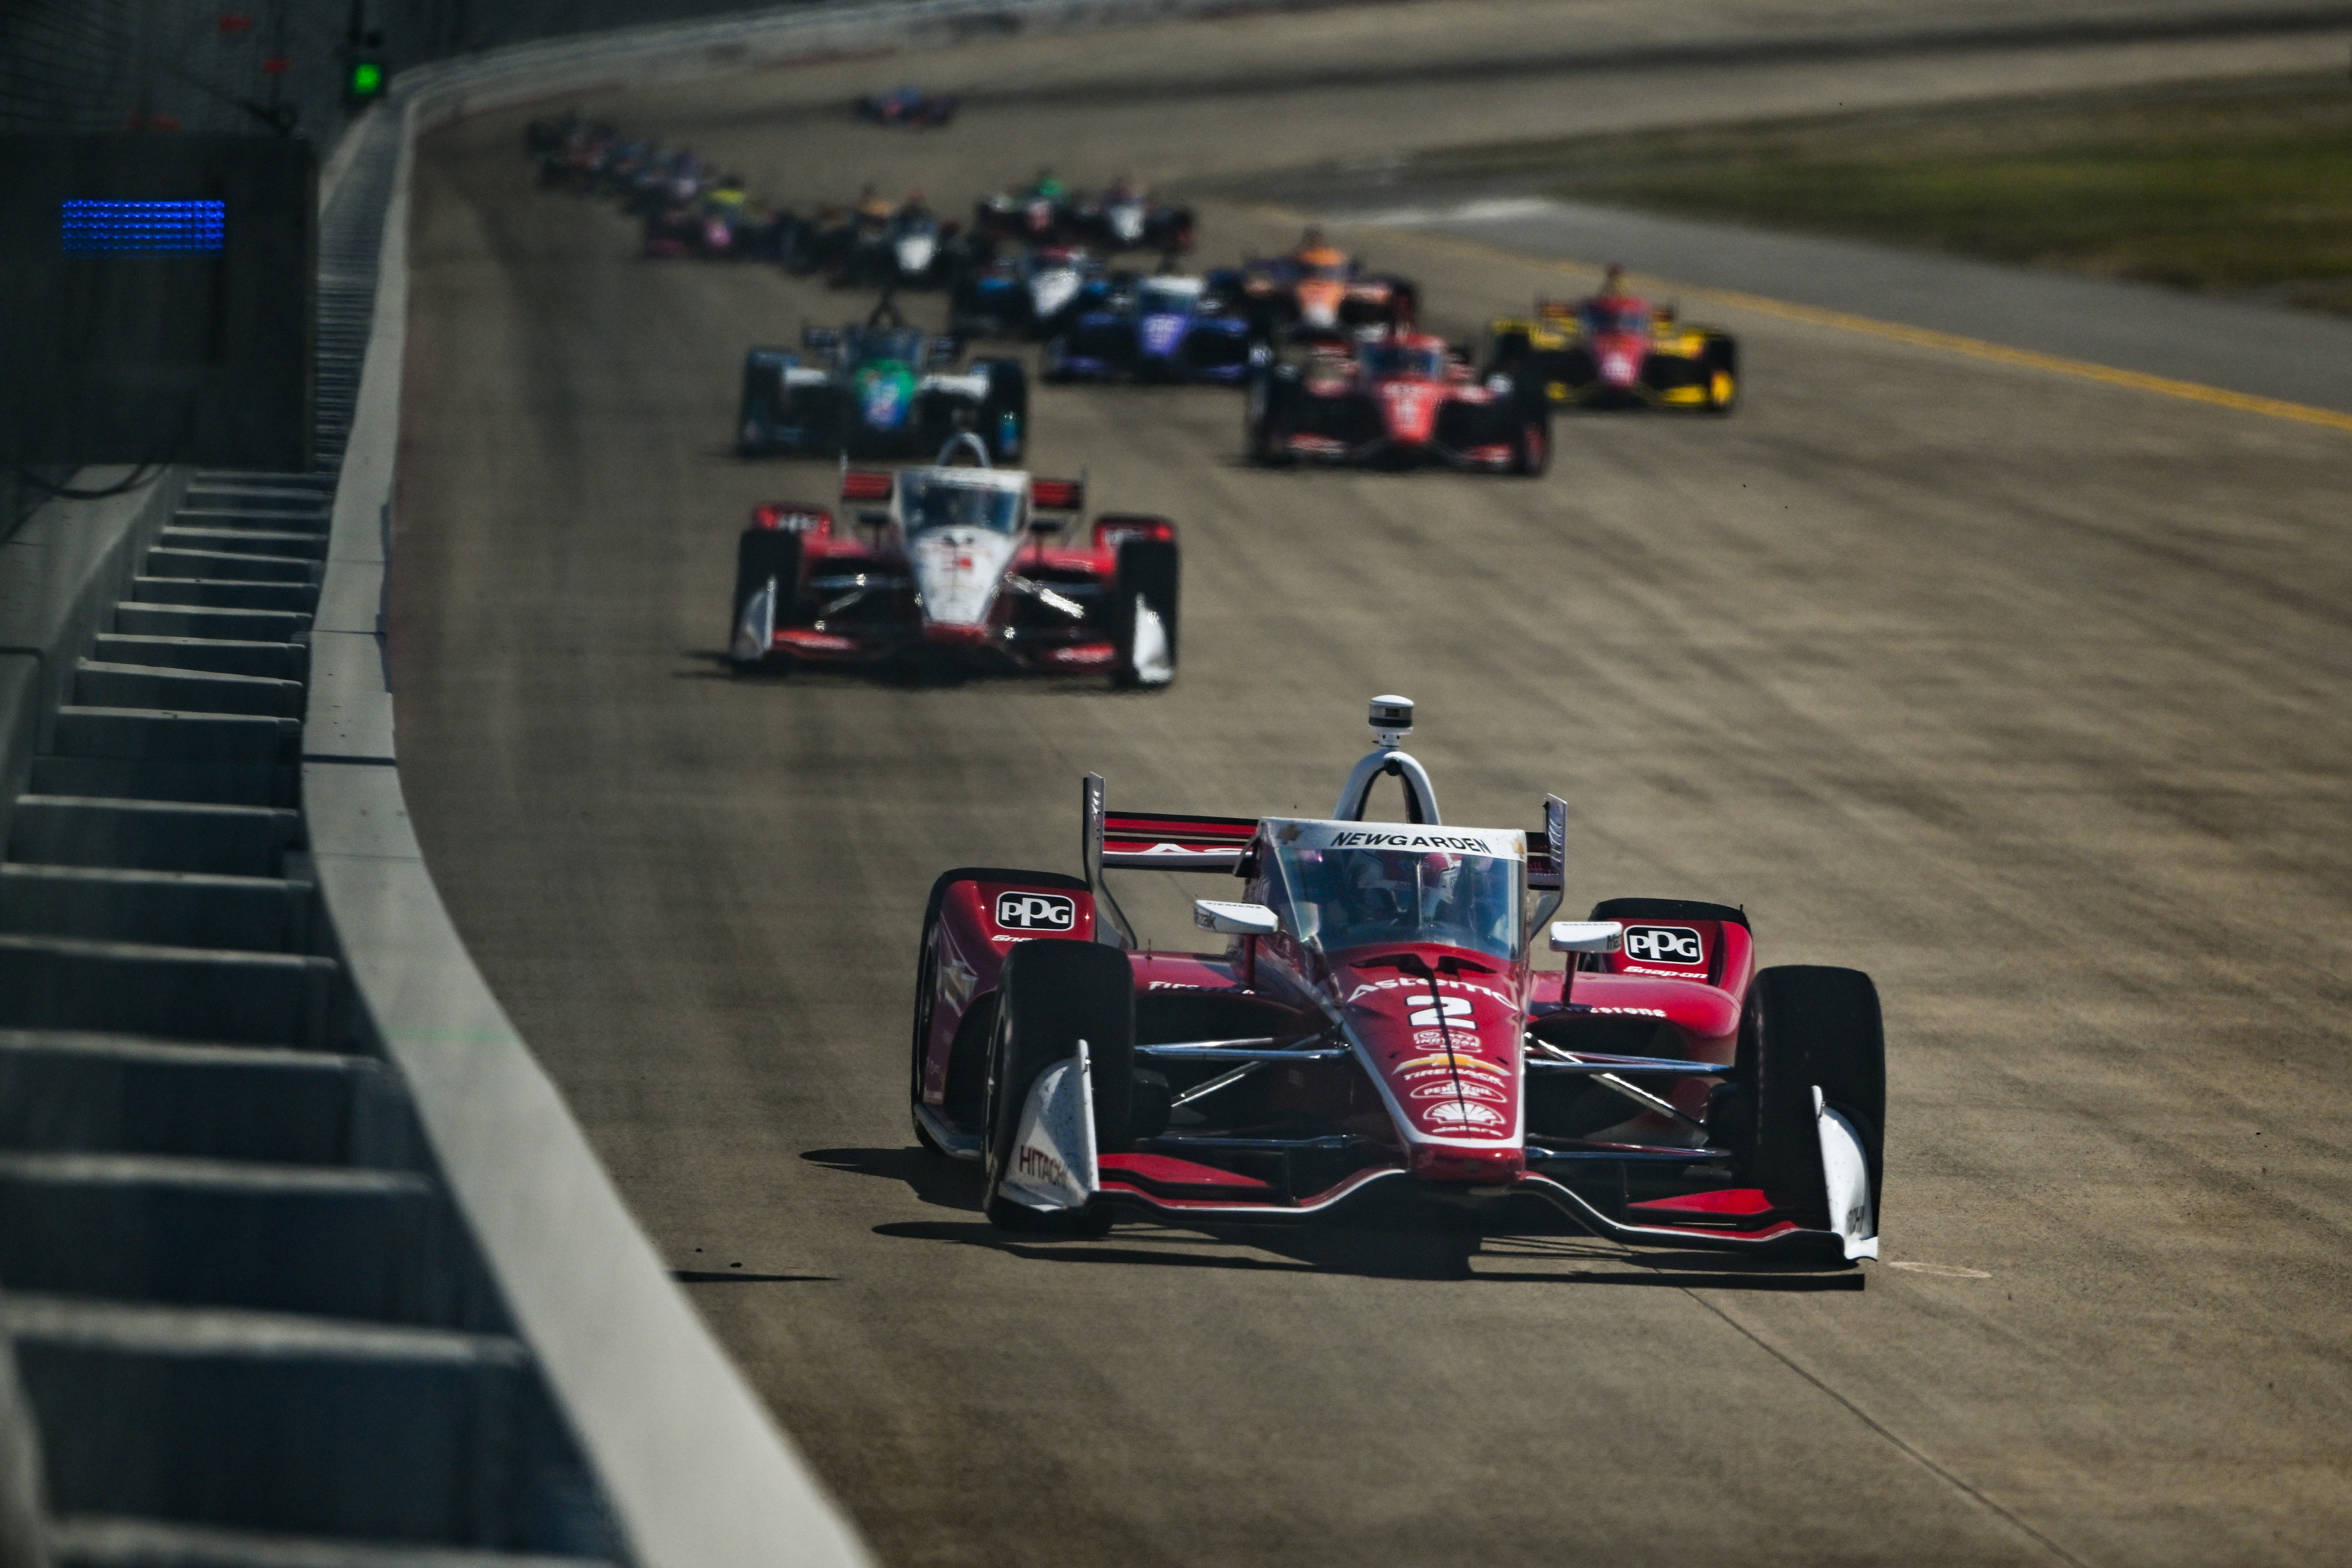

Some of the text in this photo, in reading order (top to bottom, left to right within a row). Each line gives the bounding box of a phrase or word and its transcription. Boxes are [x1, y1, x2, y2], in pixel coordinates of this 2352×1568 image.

[1330, 832, 1491, 854] NEWGARDEN
[1001, 897, 1069, 926] PPG
[1629, 930, 1697, 959] PPG
[1623, 966, 1708, 978] Snap-on
[1347, 978, 1519, 1011] Astemo
[1404, 995, 1478, 1030] 2
[1404, 1069, 1506, 1088] TIRE RACK
